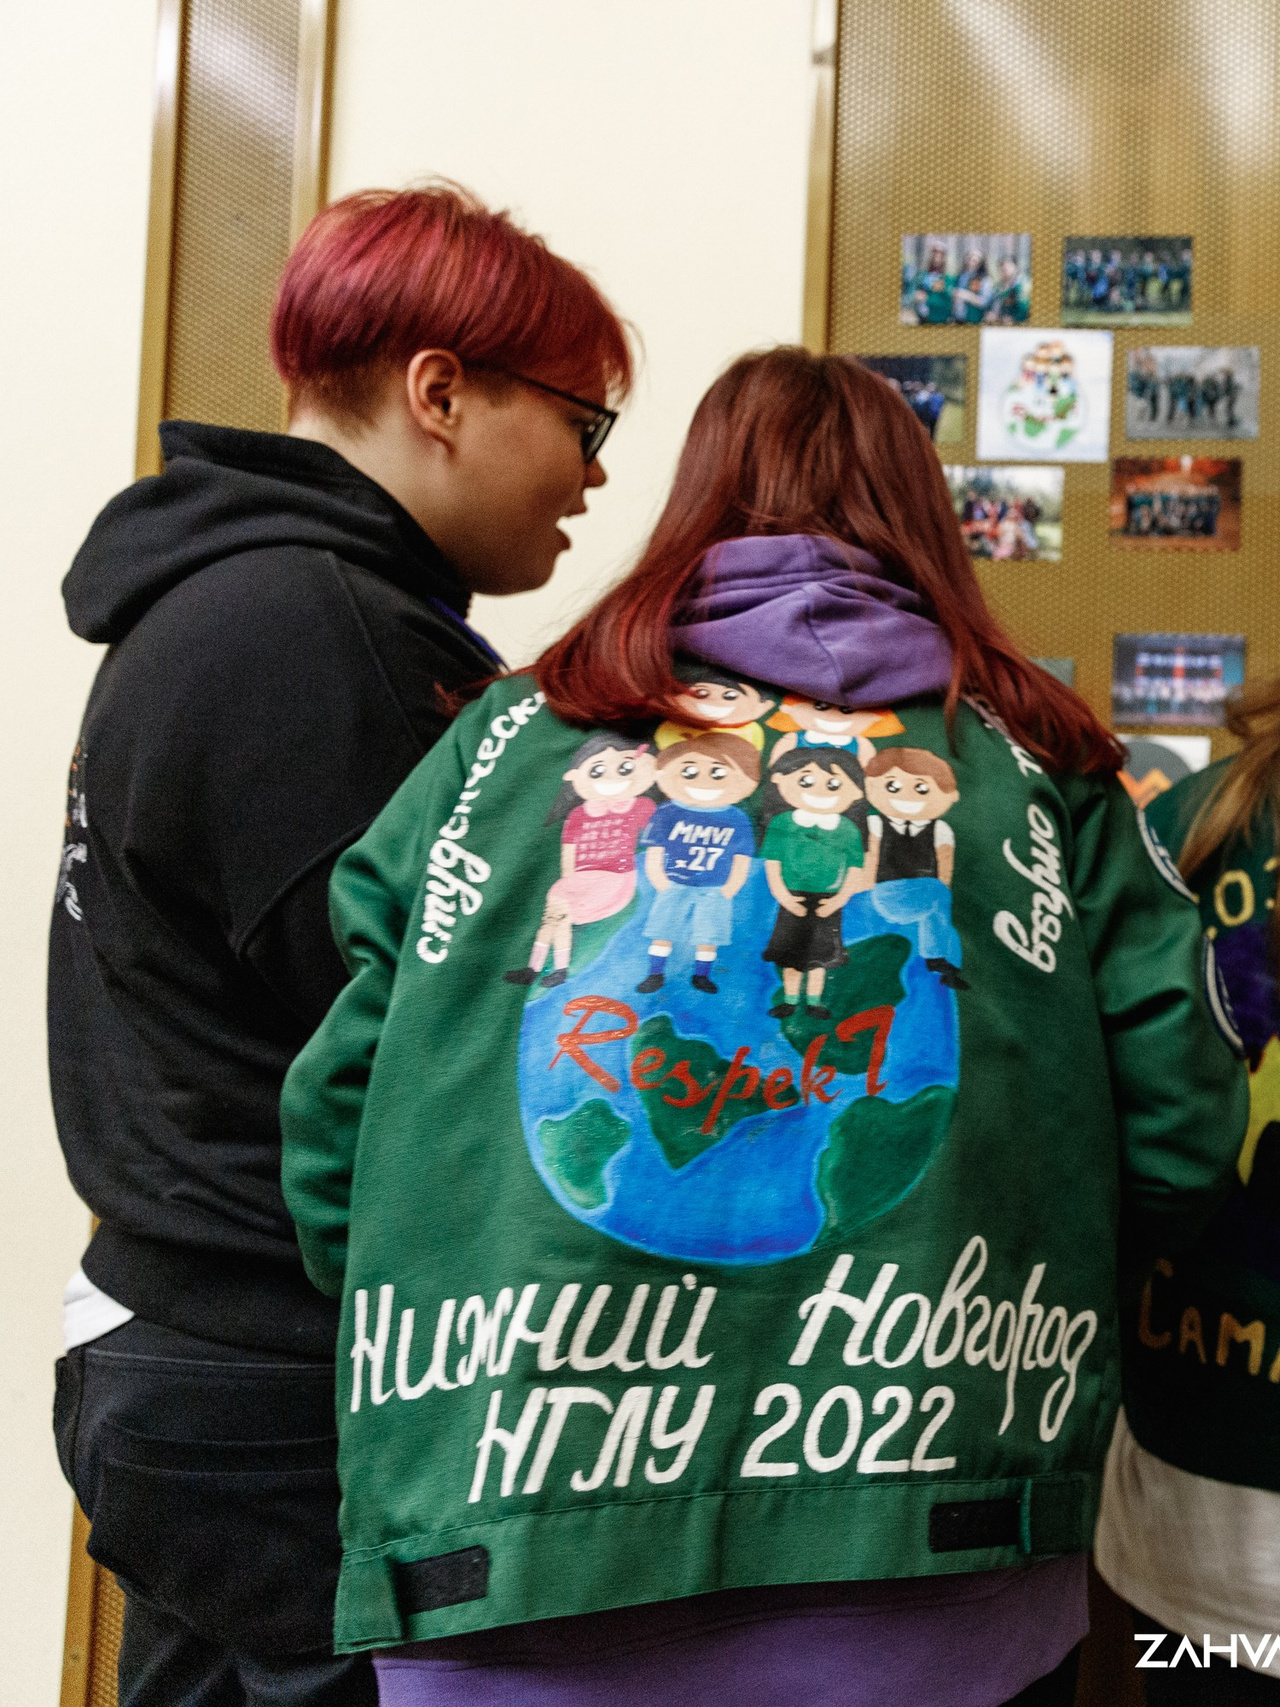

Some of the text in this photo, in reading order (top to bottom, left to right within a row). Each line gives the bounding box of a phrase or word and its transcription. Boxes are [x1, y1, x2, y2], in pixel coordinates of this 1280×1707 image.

[416, 691, 547, 963] студенческ
[668, 820, 735, 846] MMVI
[350, 1235, 1097, 1442] Нижний Новгород
[467, 1383, 956, 1503] НГЛУ 2022
